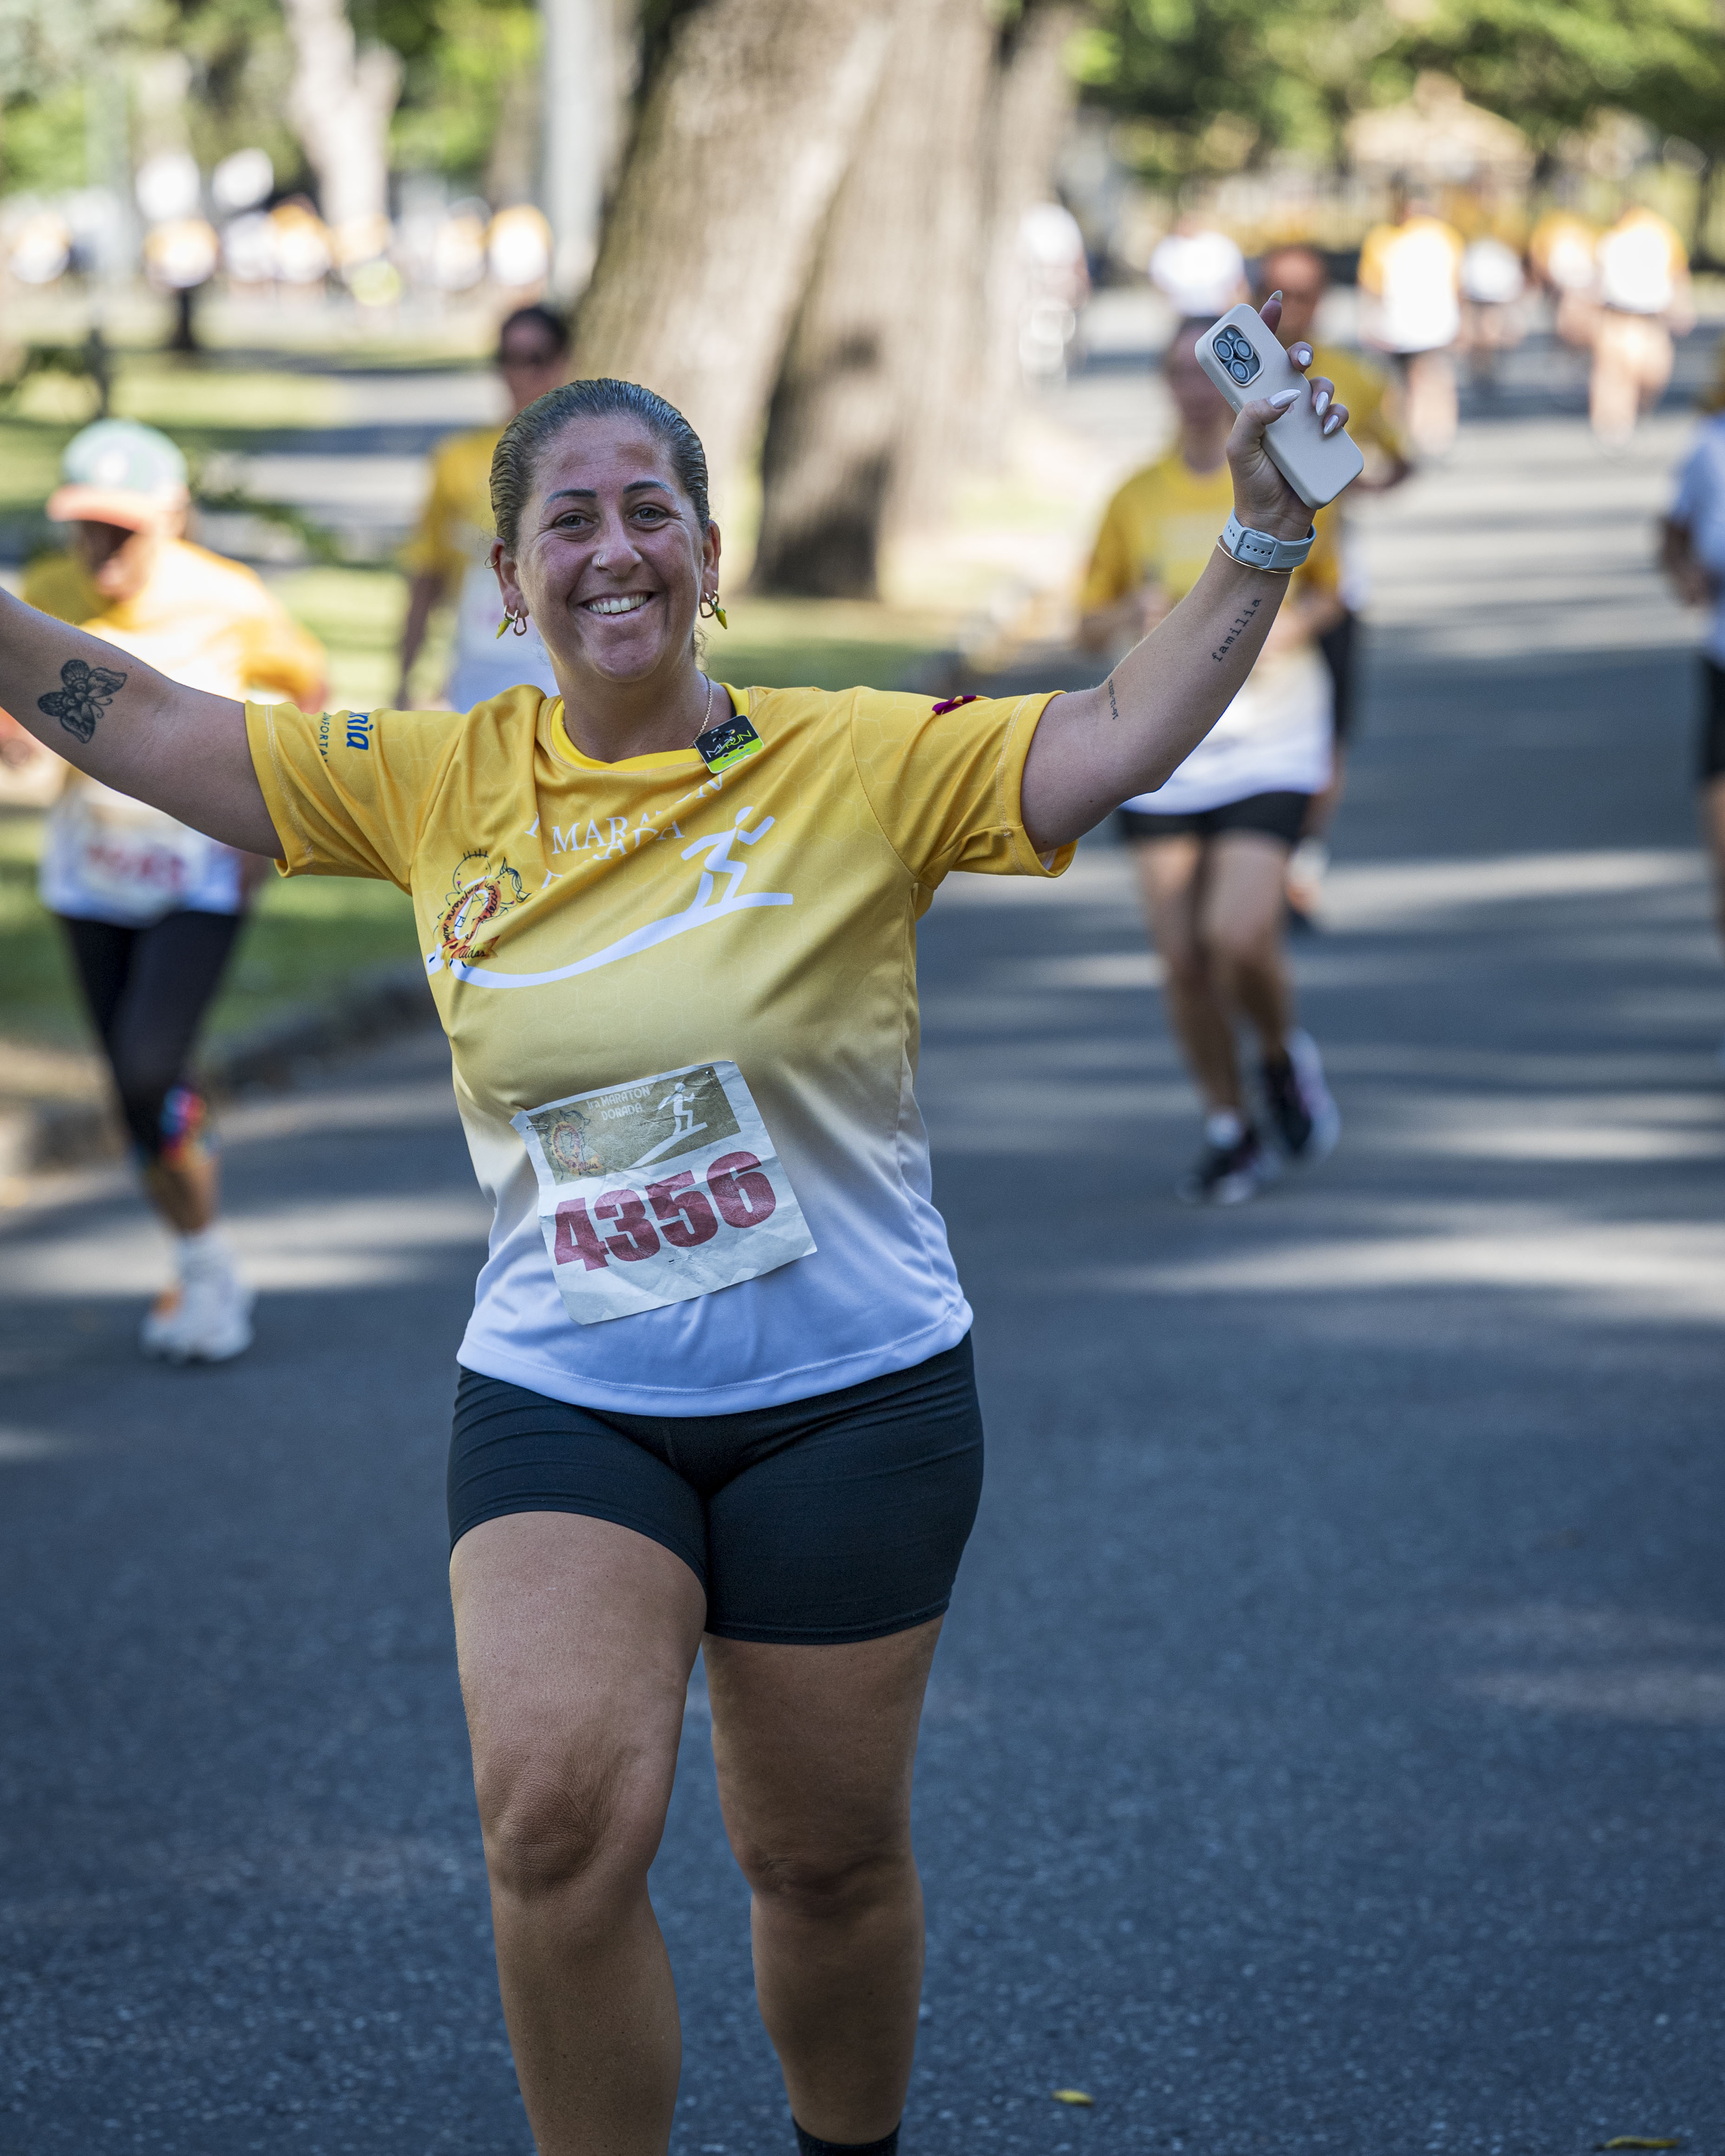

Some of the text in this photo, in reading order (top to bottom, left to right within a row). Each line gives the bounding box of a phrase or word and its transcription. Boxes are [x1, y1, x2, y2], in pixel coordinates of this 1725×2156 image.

[1211, 598, 1262, 662] familia
[347, 711, 373, 750] nia
[600, 1085, 651, 1107] MARATON
[601, 1102, 643, 1120] DORADA
[554, 1151, 777, 1271] 4356
